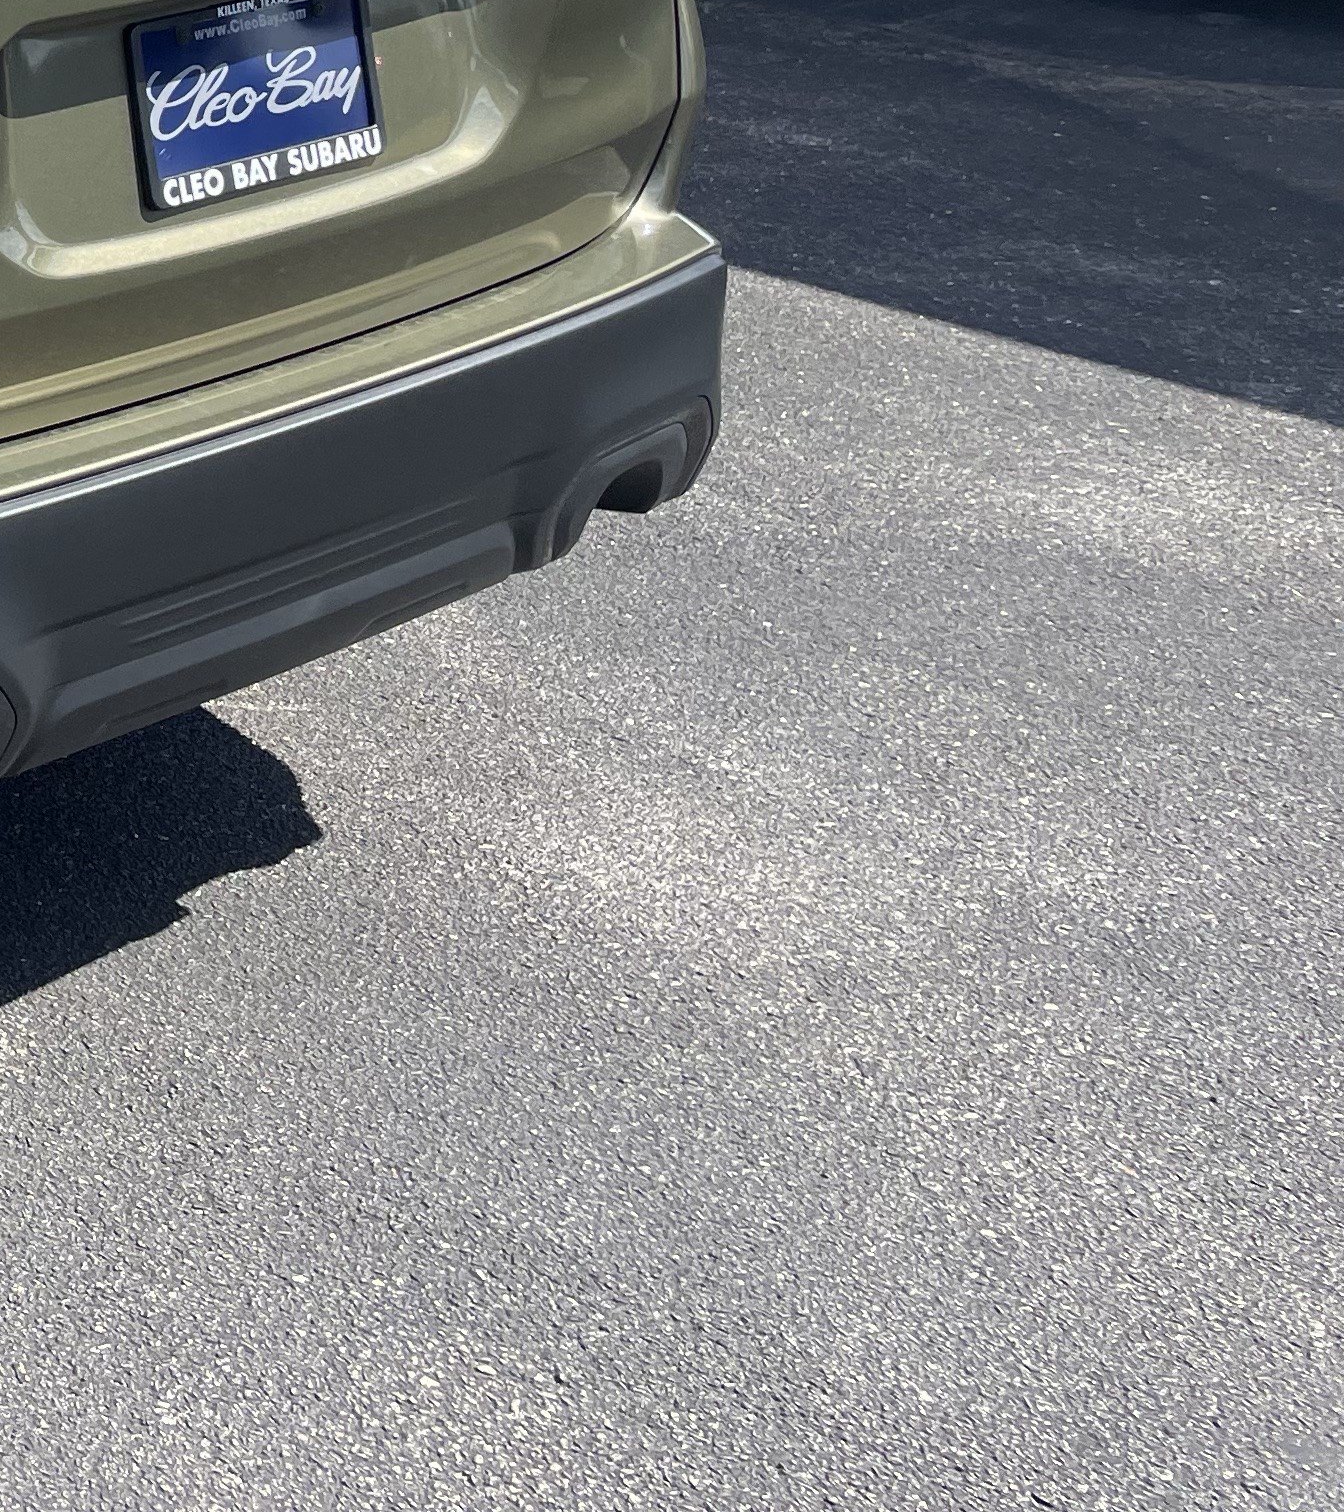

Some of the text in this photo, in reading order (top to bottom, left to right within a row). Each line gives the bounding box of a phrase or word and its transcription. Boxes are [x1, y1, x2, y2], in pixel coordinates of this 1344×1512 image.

[193, 6, 307, 41] www.CleoBay.com
[217, 0, 258, 18] KILLEEN,
[146, 45, 361, 142] Cleo Bay
[162, 127, 383, 208] CLEO BAY SUBARU
